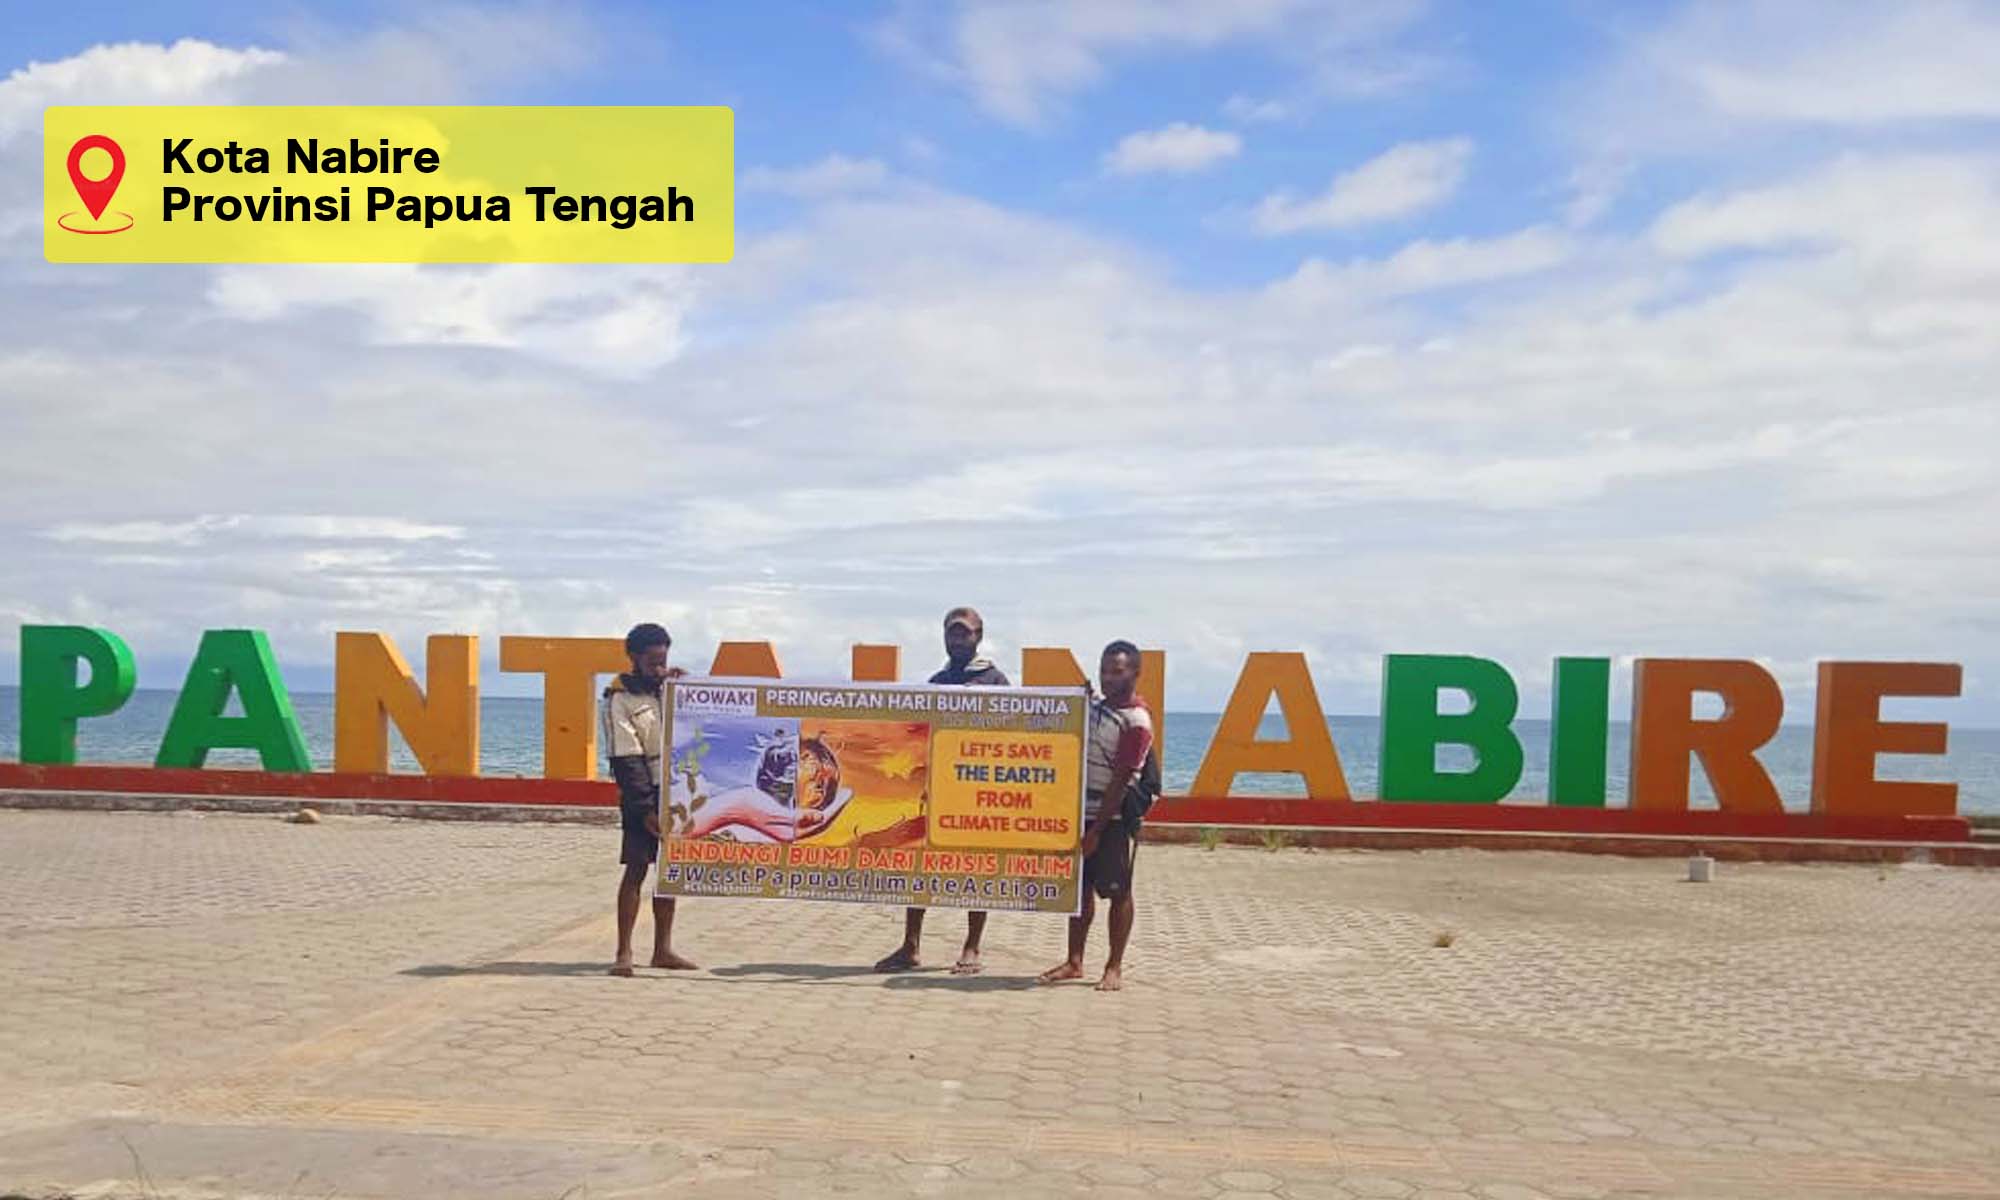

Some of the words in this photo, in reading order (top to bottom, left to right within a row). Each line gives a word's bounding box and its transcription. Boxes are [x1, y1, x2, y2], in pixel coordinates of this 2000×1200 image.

[20, 624, 901, 782] PANT
[685, 688, 755, 706] KOWAKI
[766, 689, 883, 710] PERINGATAN
[888, 694, 931, 706] HARI
[936, 695, 982, 711] BUMI
[988, 697, 1070, 715] SEDUNIA
[959, 741, 1002, 757] LET'S
[1008, 744, 1053, 760] SAVE
[954, 764, 989, 782] THE
[994, 766, 1056, 783] EARTH
[976, 790, 1032, 809] FROM
[939, 815, 1010, 832] CLIMATE
[1015, 817, 1069, 834] CRISIS
[668, 840, 781, 865] LINDUNGI
[789, 847, 850, 867] BUMI
[857, 849, 915, 871] DARI
[923, 850, 998, 873] KRISIS
[1005, 854, 1073, 878] IKLIM
[666, 864, 1060, 899] #WestPapuaClimateAction
